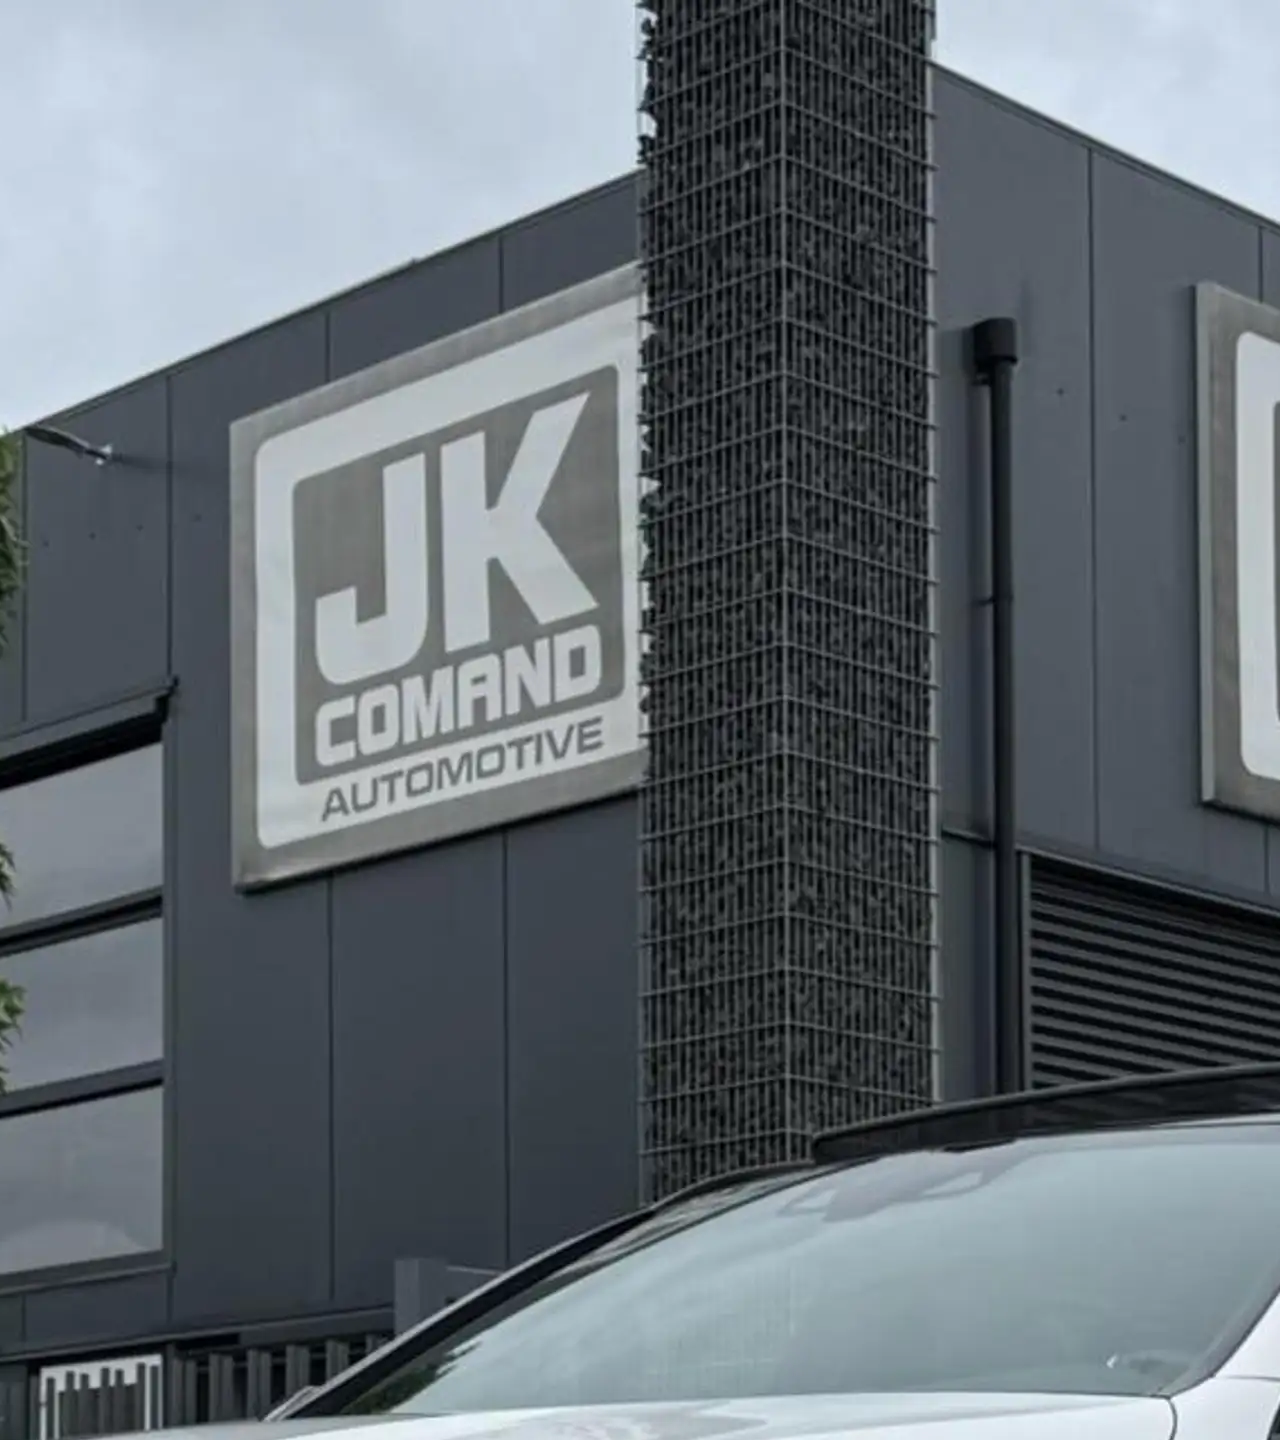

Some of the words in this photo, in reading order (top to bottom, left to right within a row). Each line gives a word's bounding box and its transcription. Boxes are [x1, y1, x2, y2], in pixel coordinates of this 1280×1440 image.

[315, 391, 599, 686] JK
[315, 624, 602, 767] COMAND
[321, 717, 604, 822] AUTOMOTIVE
